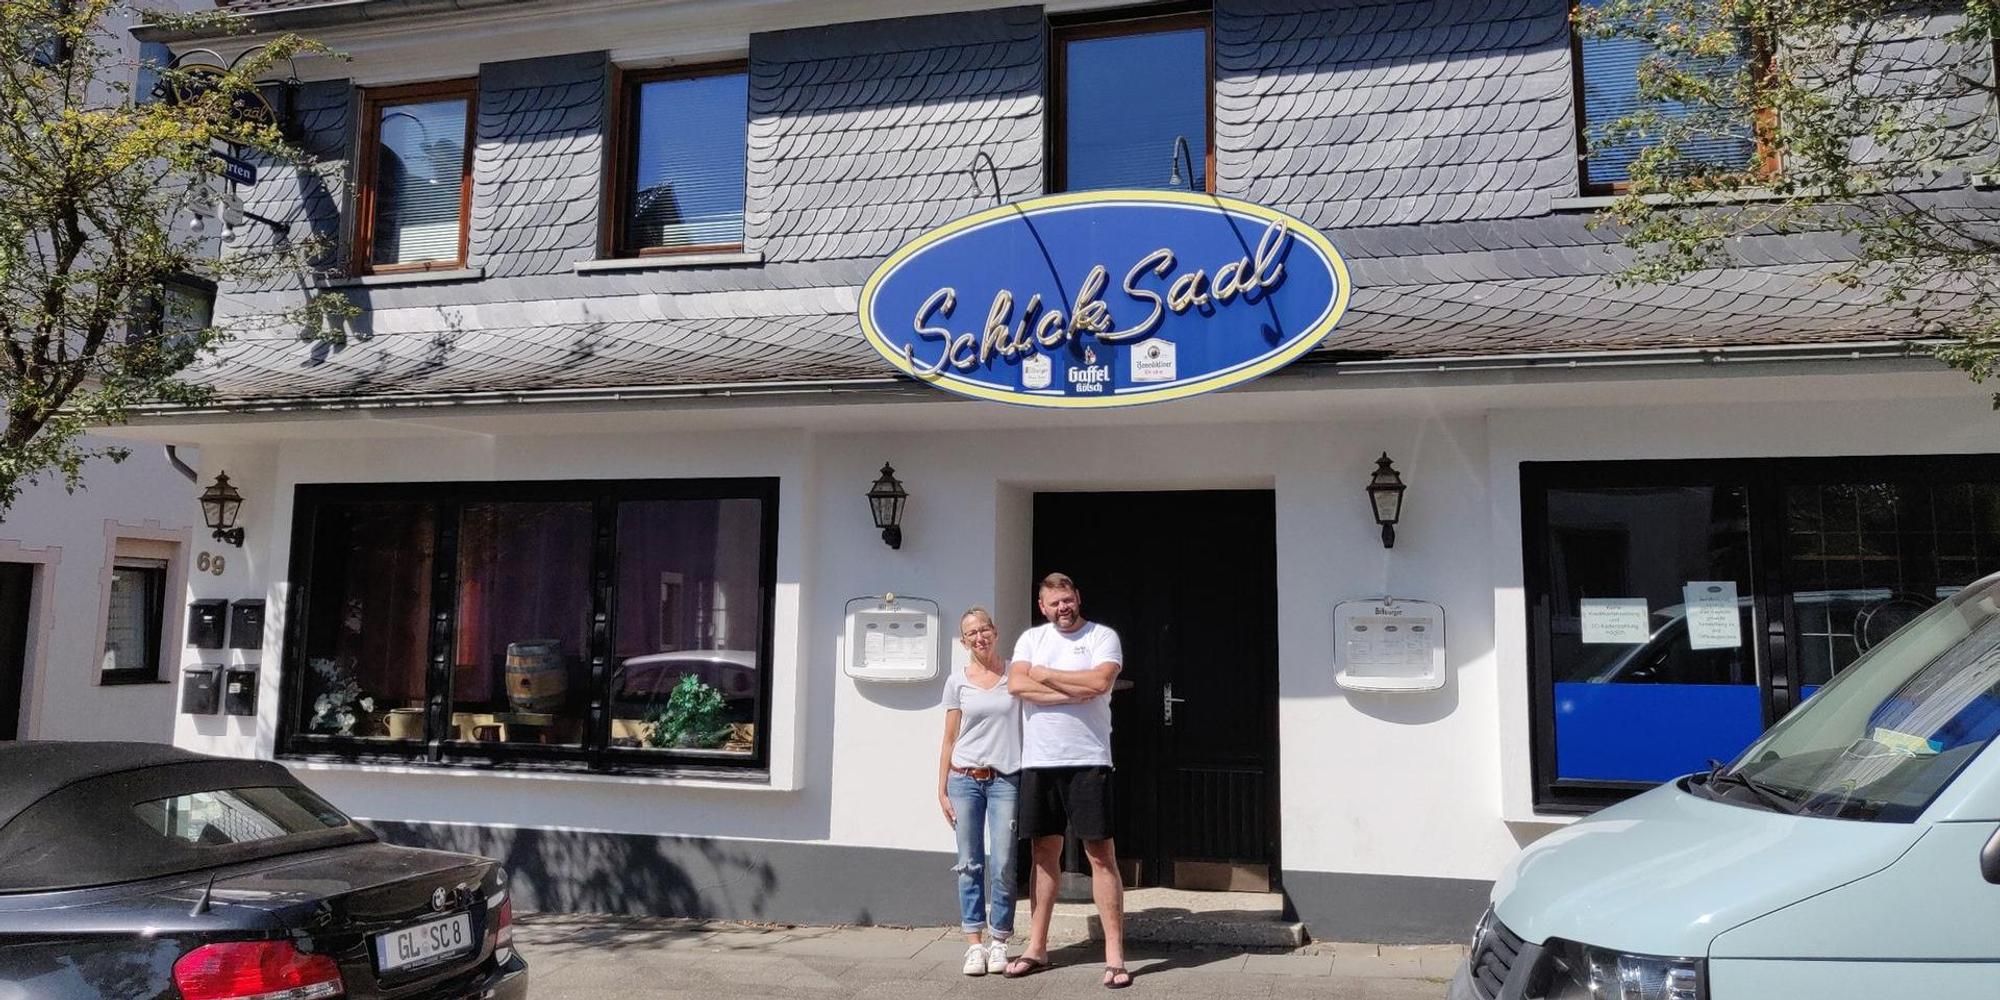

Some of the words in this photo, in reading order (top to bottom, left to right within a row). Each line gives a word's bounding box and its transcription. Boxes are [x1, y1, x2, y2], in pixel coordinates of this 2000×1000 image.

[1068, 365, 1111, 383] Gaffel
[1076, 383, 1103, 393] Kölsch
[197, 551, 225, 576] 69
[397, 932, 420, 960] GL
[430, 923, 450, 951] SC
[452, 920, 461, 944] 8
